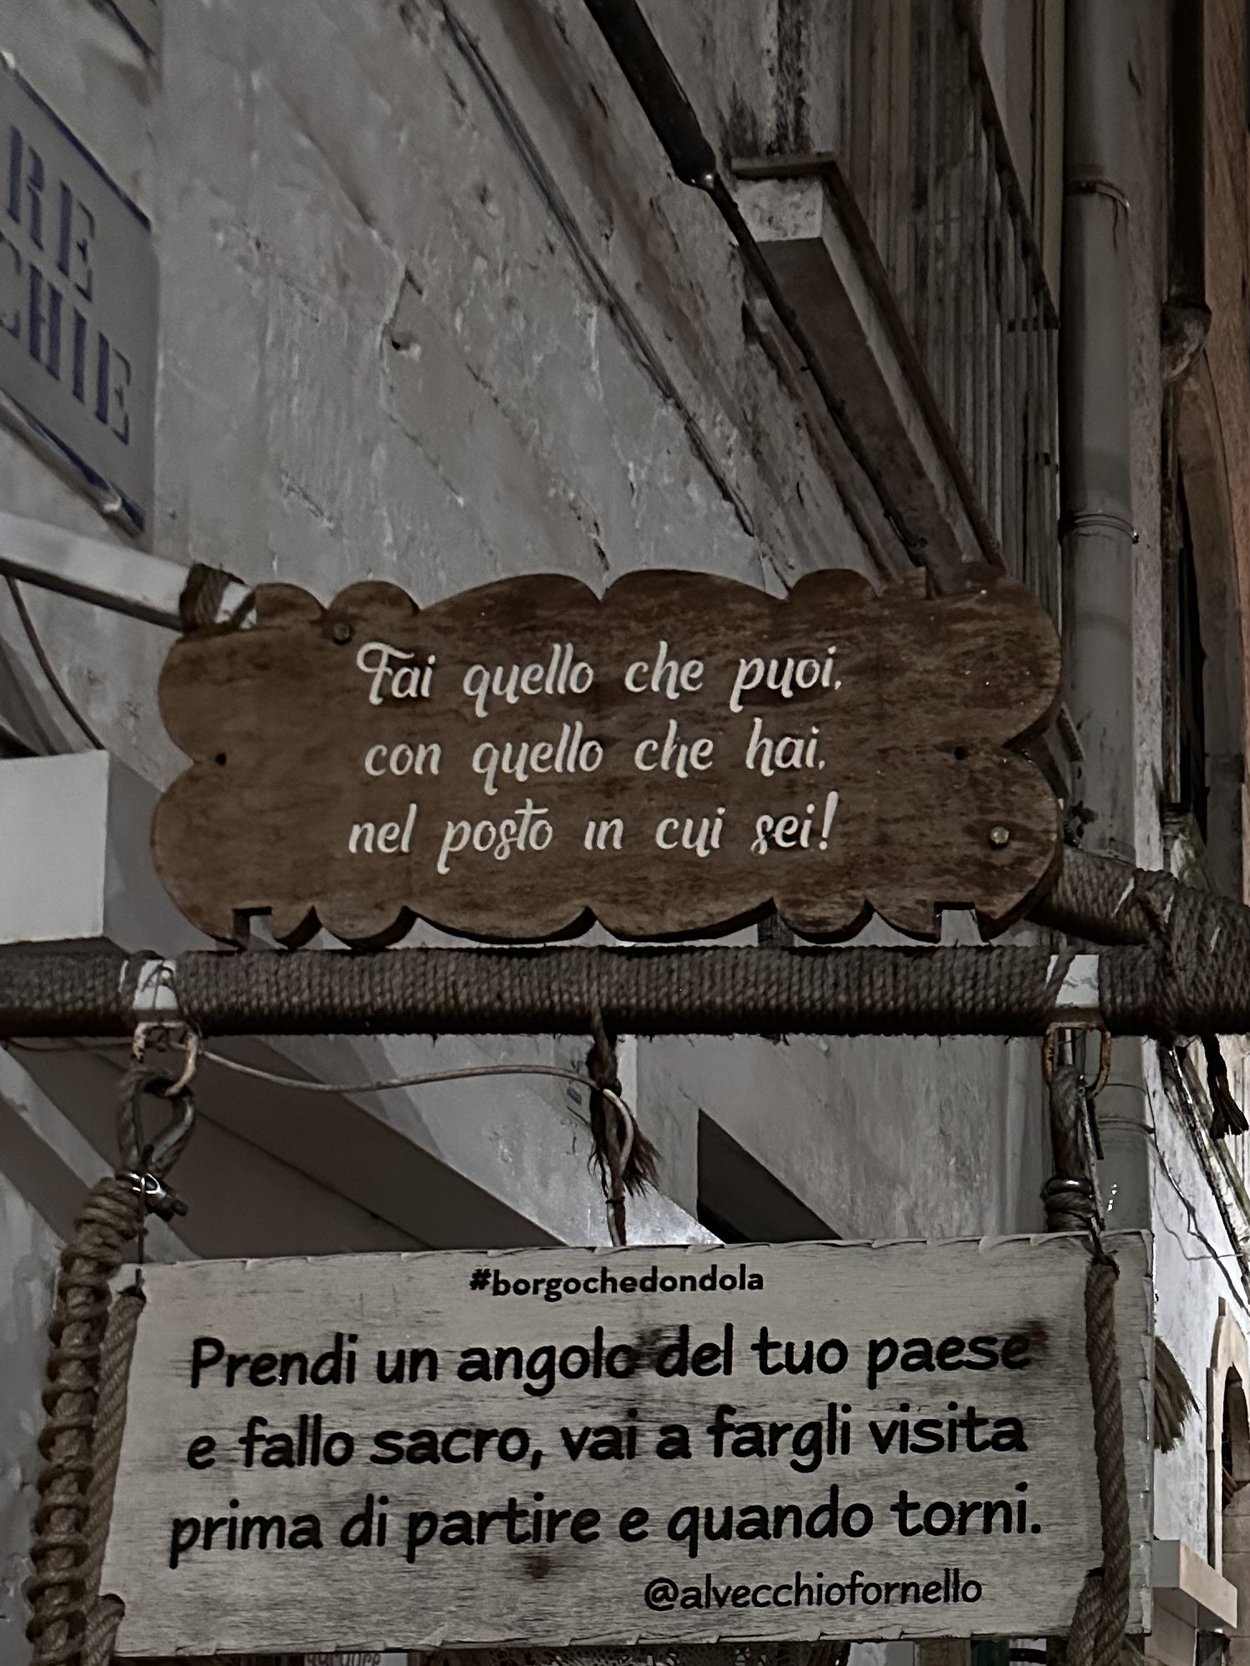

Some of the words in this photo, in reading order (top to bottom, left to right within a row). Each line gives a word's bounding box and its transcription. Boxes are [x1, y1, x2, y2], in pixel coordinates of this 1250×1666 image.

[9, 125, 95, 303] RE
[356, 641, 436, 706] Fai
[462, 643, 594, 718] quello
[624, 640, 704, 700] che
[730, 645, 842, 714] puoi,
[364, 743, 442, 777] con
[471, 719, 604, 796] quello
[634, 718, 714, 779] che
[745, 716, 826, 777] hai,
[348, 803, 418, 854] nel
[436, 797, 554, 875] posto
[583, 818, 624, 851] in
[655, 806, 726, 858] cui
[750, 790, 840, 856] sei!
[469, 1263, 765, 1303] #borgochedondola
[189, 1331, 359, 1389] Prendi
[376, 1348, 439, 1384] un
[456, 1325, 636, 1397] angolo
[655, 1322, 734, 1378] del
[750, 1326, 849, 1376] tuo
[867, 1332, 1033, 1391] paese
[186, 1435, 217, 1470] e
[237, 1413, 355, 1469] fallo
[369, 1427, 545, 1471] sacro,
[560, 1408, 639, 1462] vai
[655, 1423, 692, 1460] a
[706, 1401, 852, 1474] fargli
[868, 1401, 1029, 1455] visita
[169, 1498, 324, 1570] prima
[339, 1492, 390, 1548] di
[404, 1491, 601, 1565] partire
[618, 1507, 649, 1543] e
[667, 1483, 874, 1559] quando
[890, 1481, 1042, 1537] torni.
[644, 1567, 983, 1612] @alvecchiofornello
